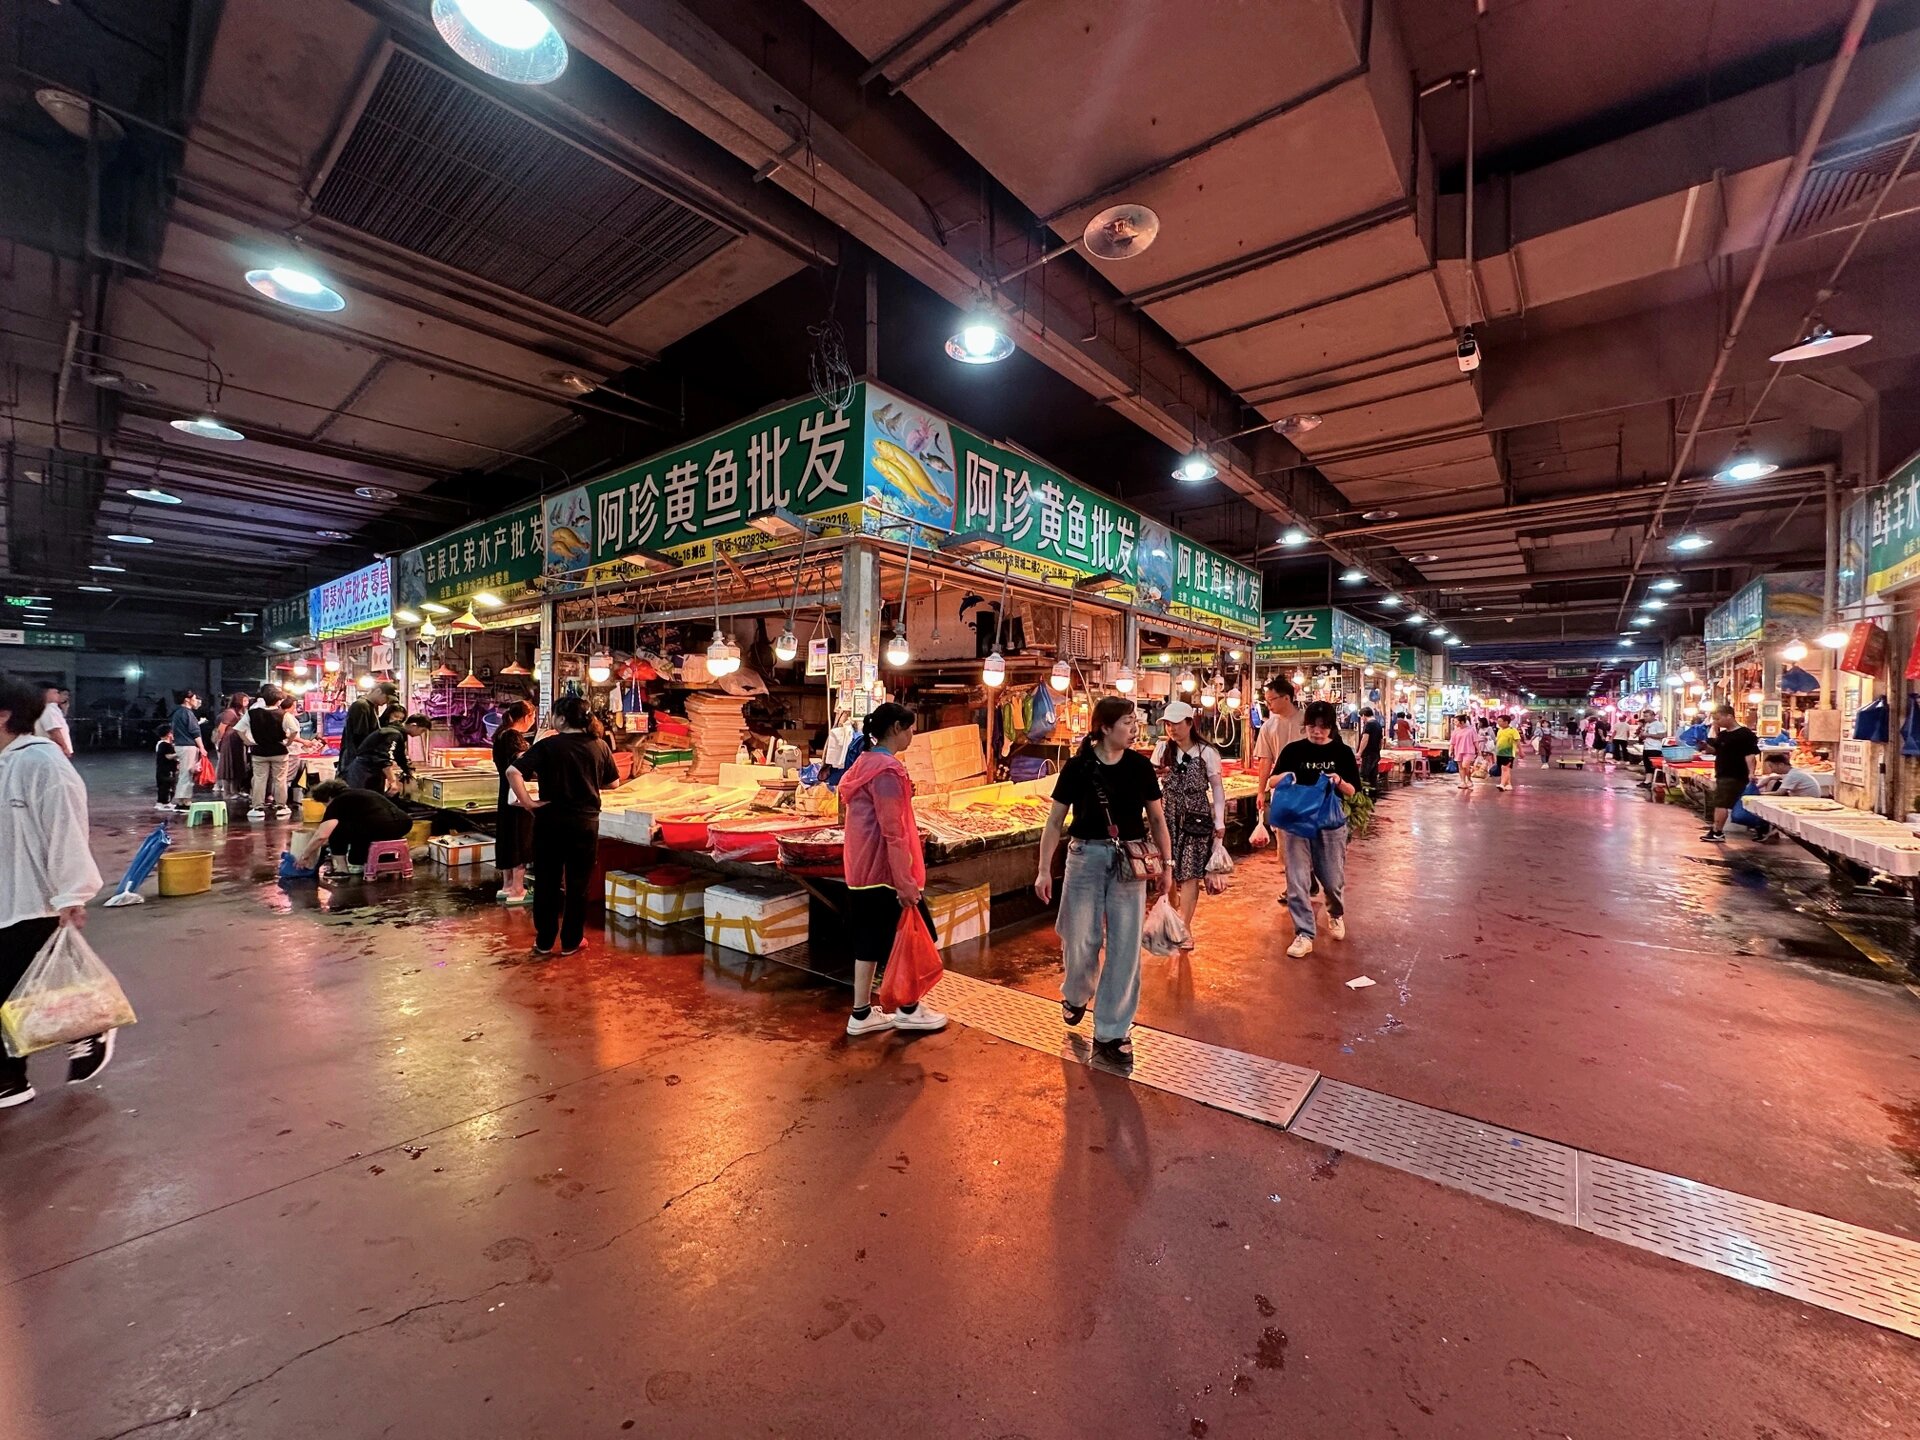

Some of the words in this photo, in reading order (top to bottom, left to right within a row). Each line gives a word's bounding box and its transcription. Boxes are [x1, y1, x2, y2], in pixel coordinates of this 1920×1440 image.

[597, 408, 851, 557] 阿珍黄鱼批发
[965, 450, 1136, 579] 阿珍黄鱼批发
[426, 514, 545, 583] 志展兄弟水产批发
[1176, 542, 1260, 613] 阿胜海鲜批发
[322, 562, 390, 614] 阿琴水产批发零售
